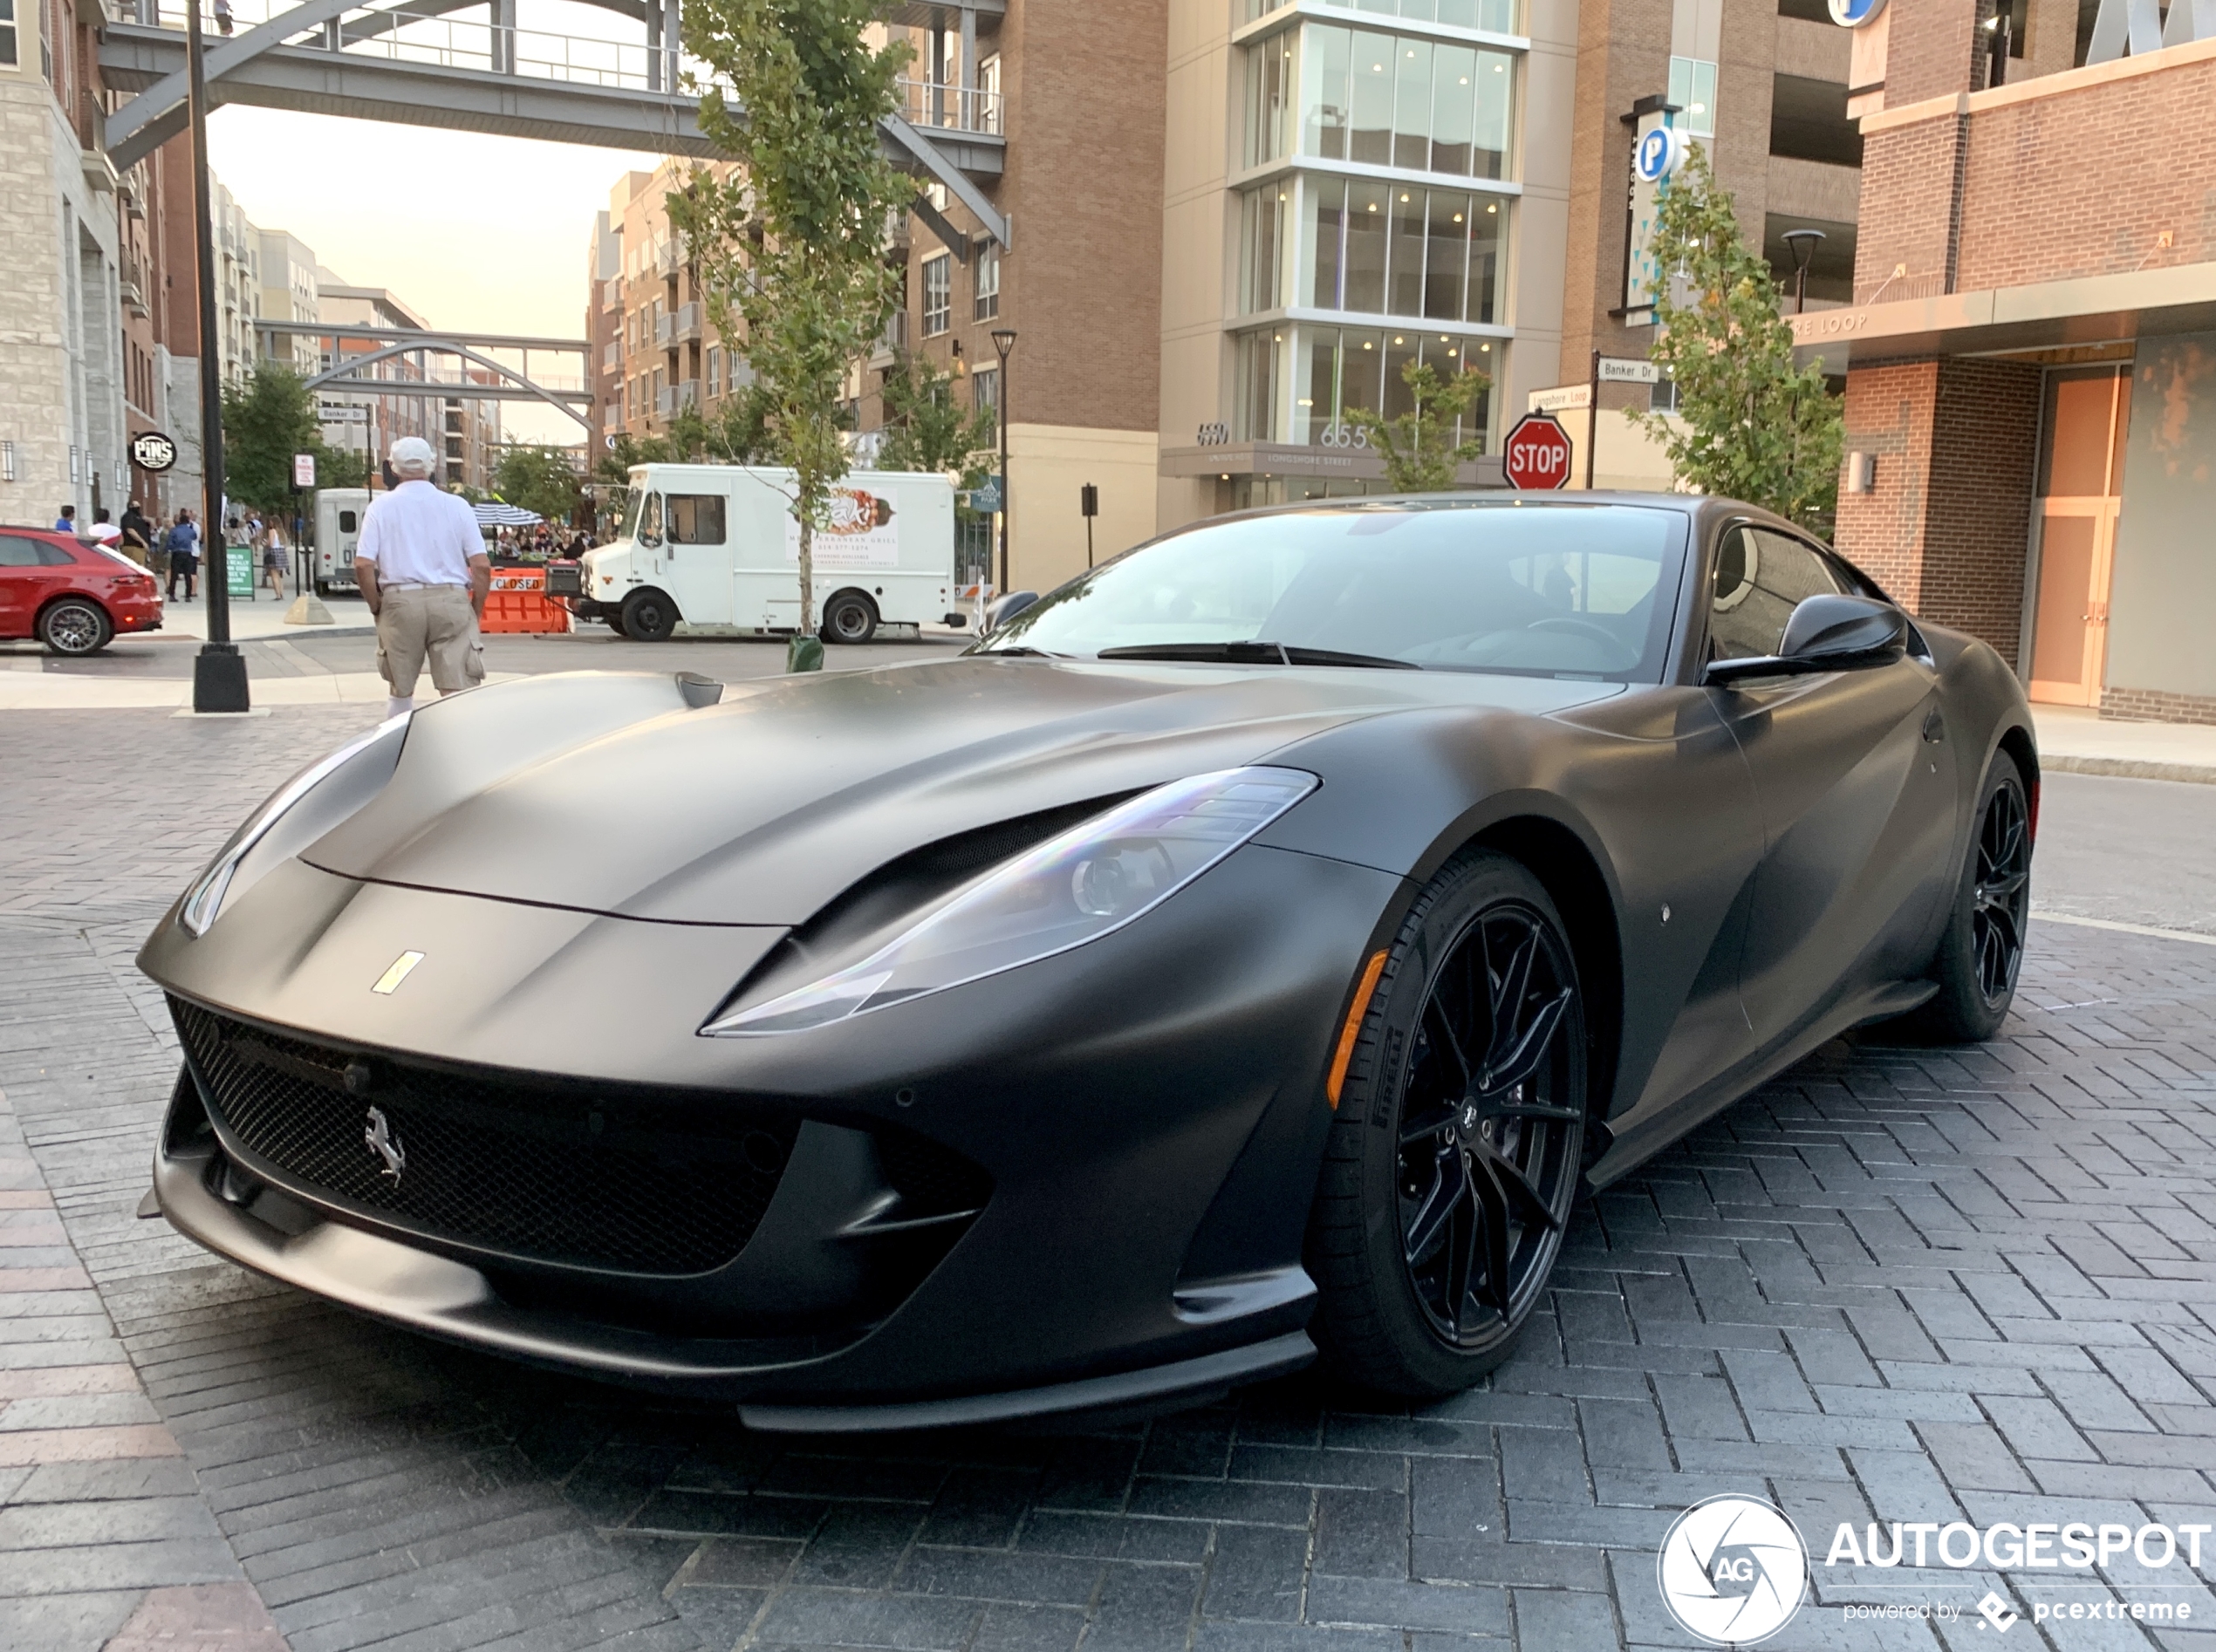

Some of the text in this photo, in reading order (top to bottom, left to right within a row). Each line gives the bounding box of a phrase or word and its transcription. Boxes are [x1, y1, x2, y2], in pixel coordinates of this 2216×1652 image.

[1821, 313, 1867, 334] LOOP
[1604, 363, 1652, 378] Banker Dr
[1533, 391, 1587, 407] Longshore Loop
[1268, 454, 1351, 467] LONGSHORE STREET
[1512, 443, 1564, 474] STOP
[496, 578, 539, 589] CLOSED
[1371, 1025, 1404, 1129] PIRELLI
